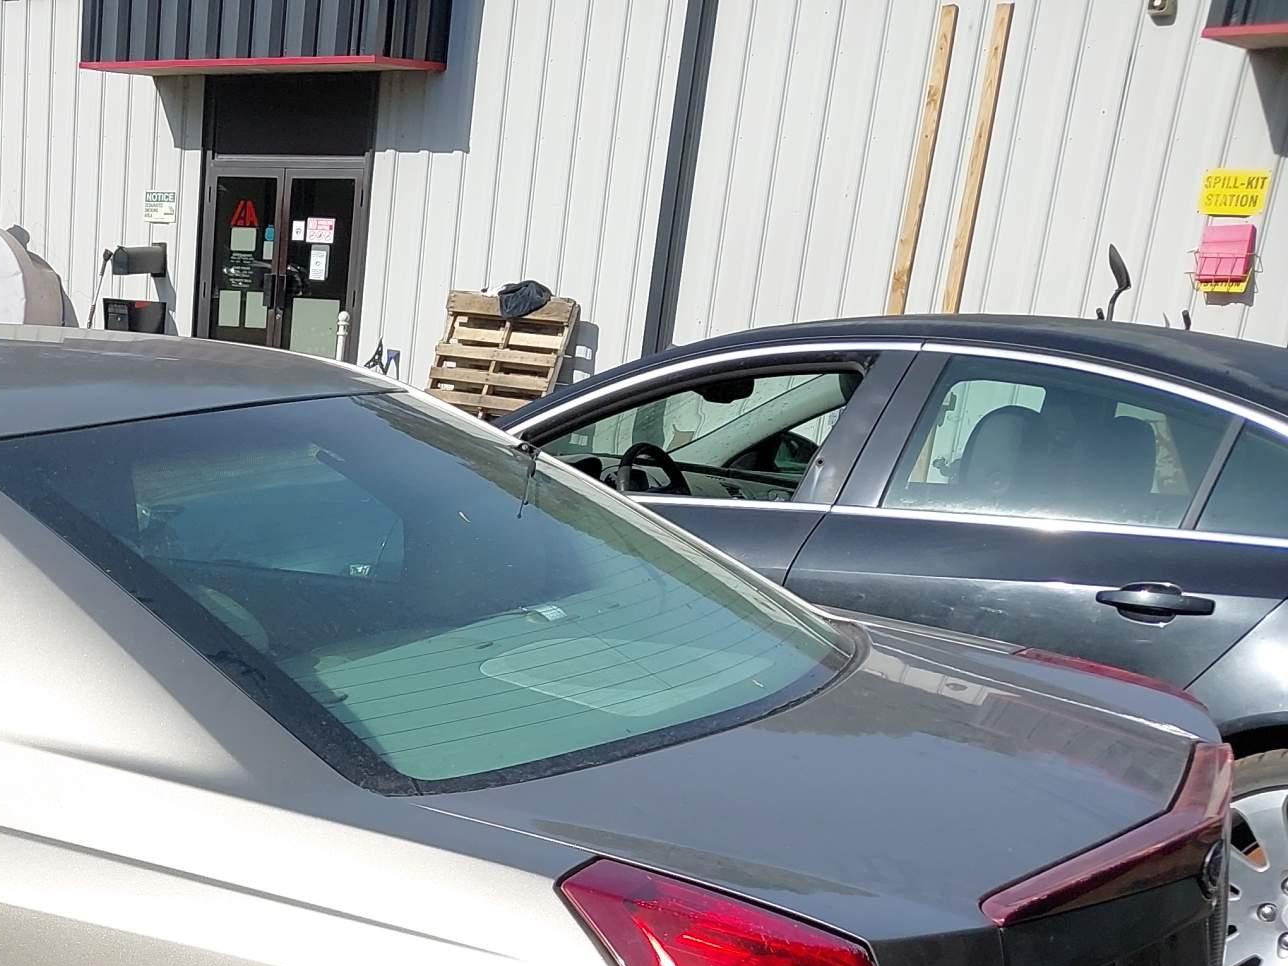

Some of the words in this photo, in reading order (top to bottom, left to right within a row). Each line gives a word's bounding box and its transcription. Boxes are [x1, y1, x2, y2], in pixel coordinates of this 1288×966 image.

[1204, 175, 1269, 190] SPILL-KIT
[146, 192, 175, 202] NOTICE
[1204, 192, 1260, 208] STATION
